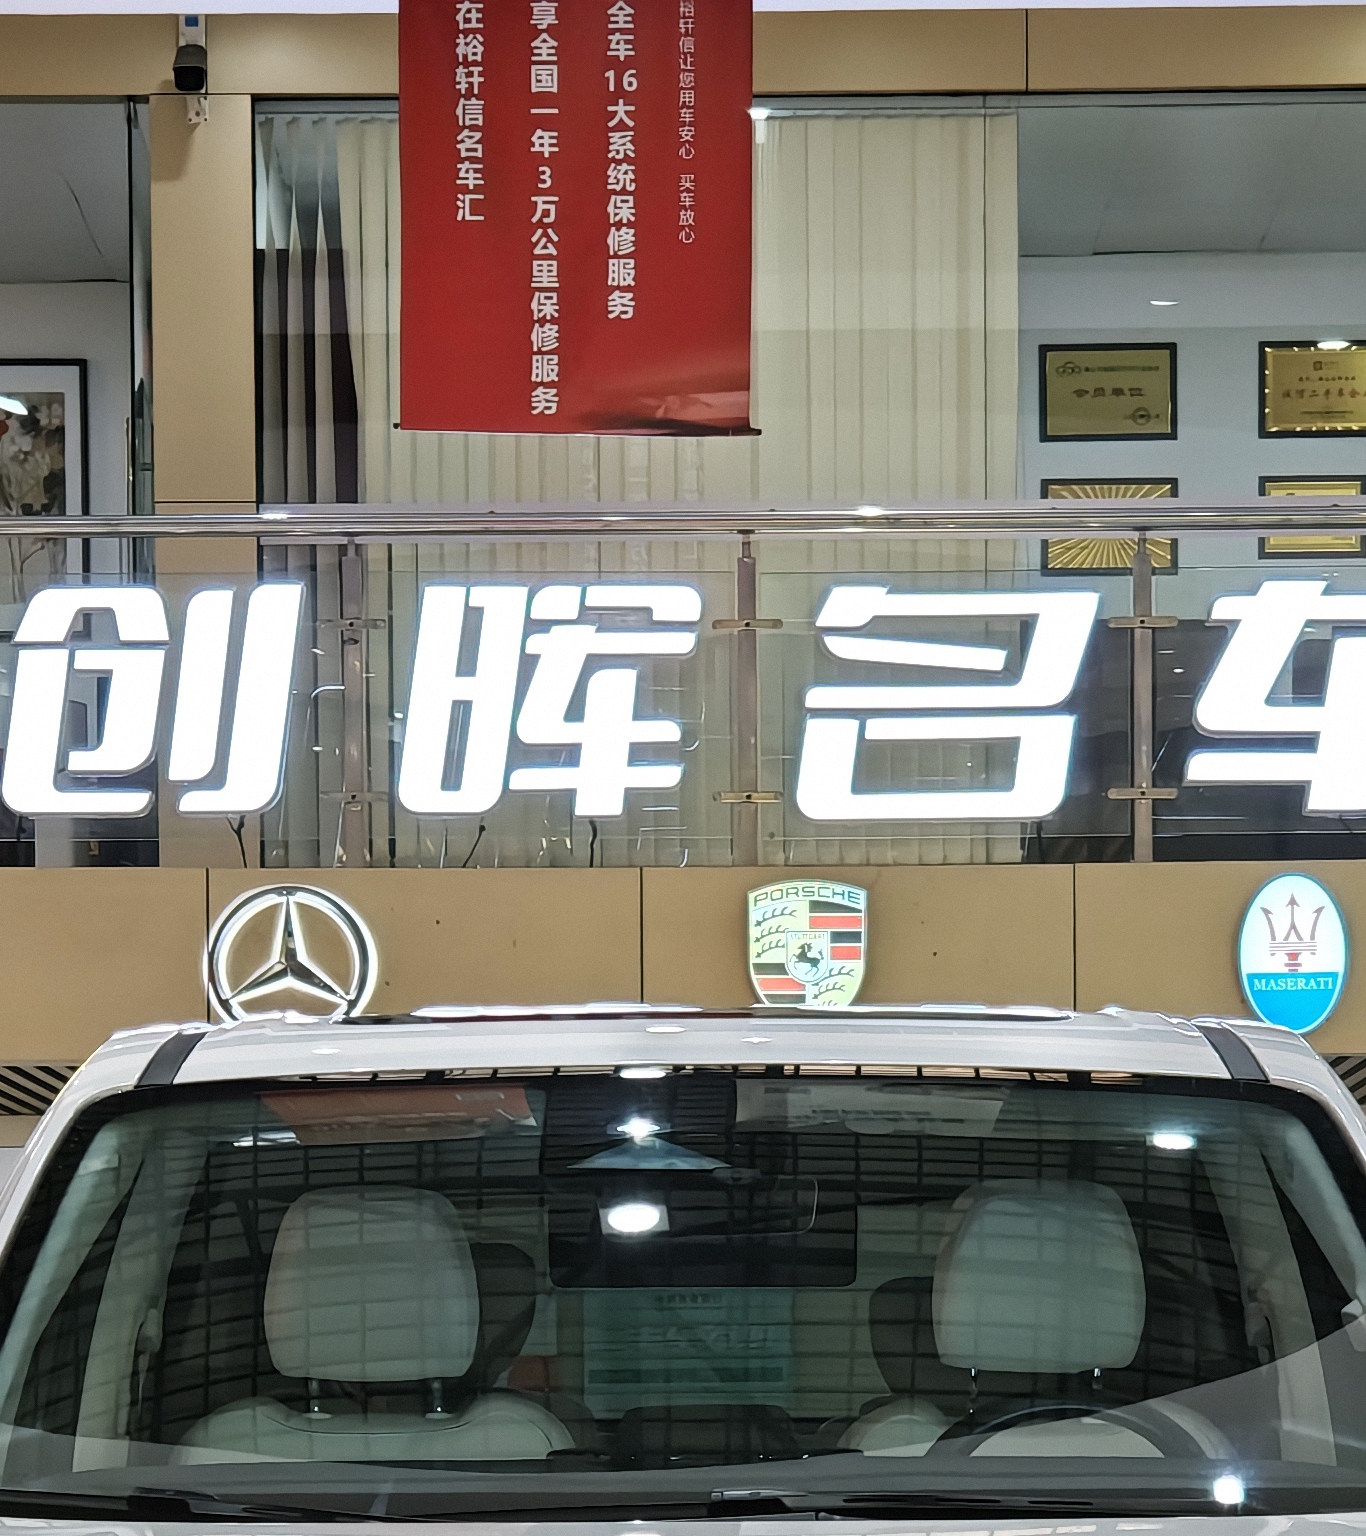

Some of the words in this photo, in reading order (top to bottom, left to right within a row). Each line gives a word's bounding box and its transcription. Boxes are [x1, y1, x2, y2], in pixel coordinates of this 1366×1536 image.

[454, 1, 485, 222] 在裕轩信名车汇
[603, 1, 638, 320] 全车16大系统保修服务
[529, 1, 560, 415] 享全国一年3万公里保修服务
[678, 174, 696, 244] 买车放心
[753, 885, 861, 908] PORSCHE
[1253, 977, 1333, 991] MASERATI
